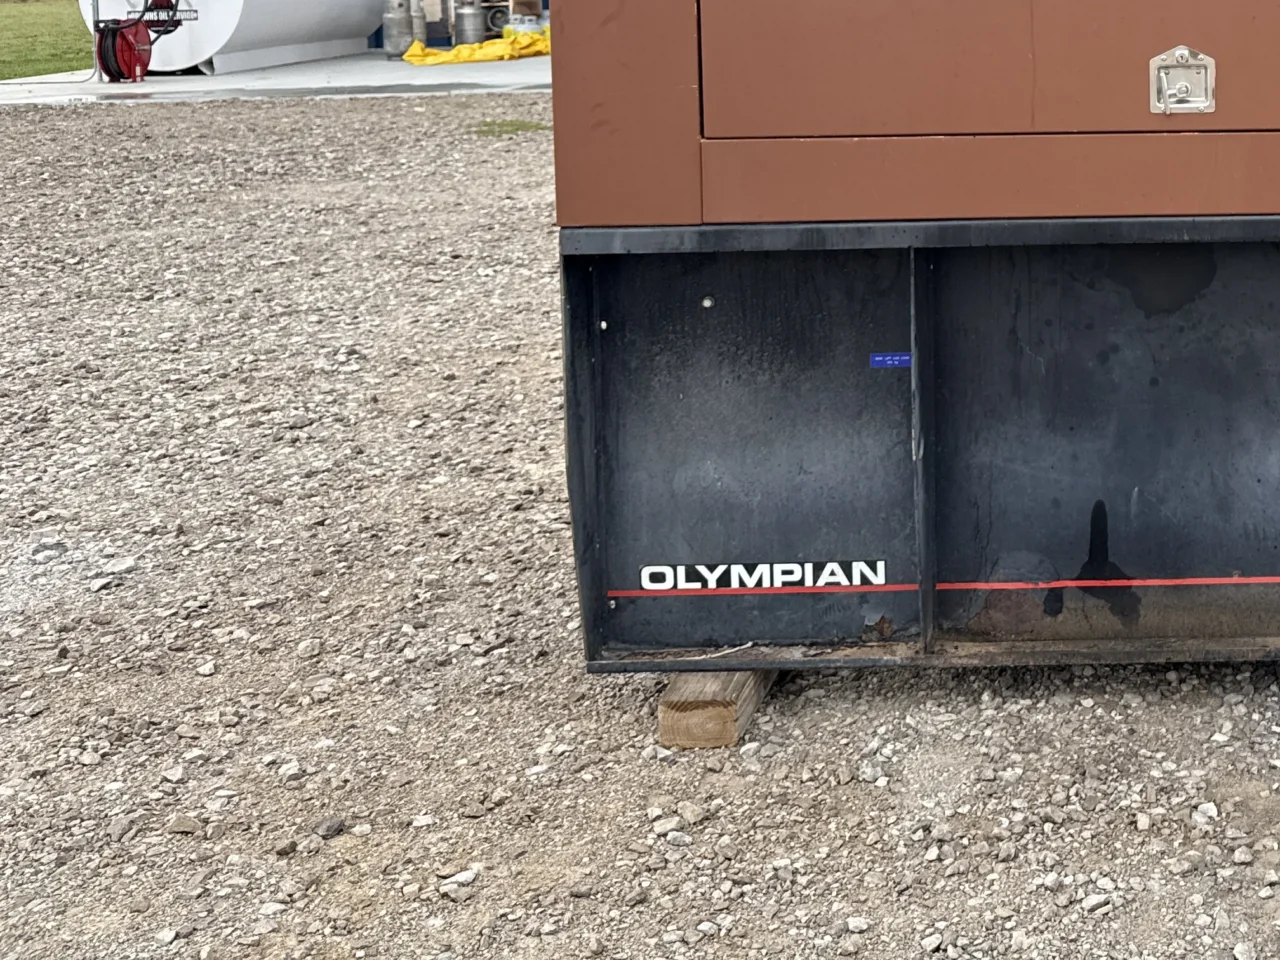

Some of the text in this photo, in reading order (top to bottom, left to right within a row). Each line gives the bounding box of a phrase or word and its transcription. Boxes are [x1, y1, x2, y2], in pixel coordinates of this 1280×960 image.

[159, 11, 168, 20] OIL
[169, 11, 194, 20] SRVICE
[641, 560, 886, 590] OLYMPIAN
